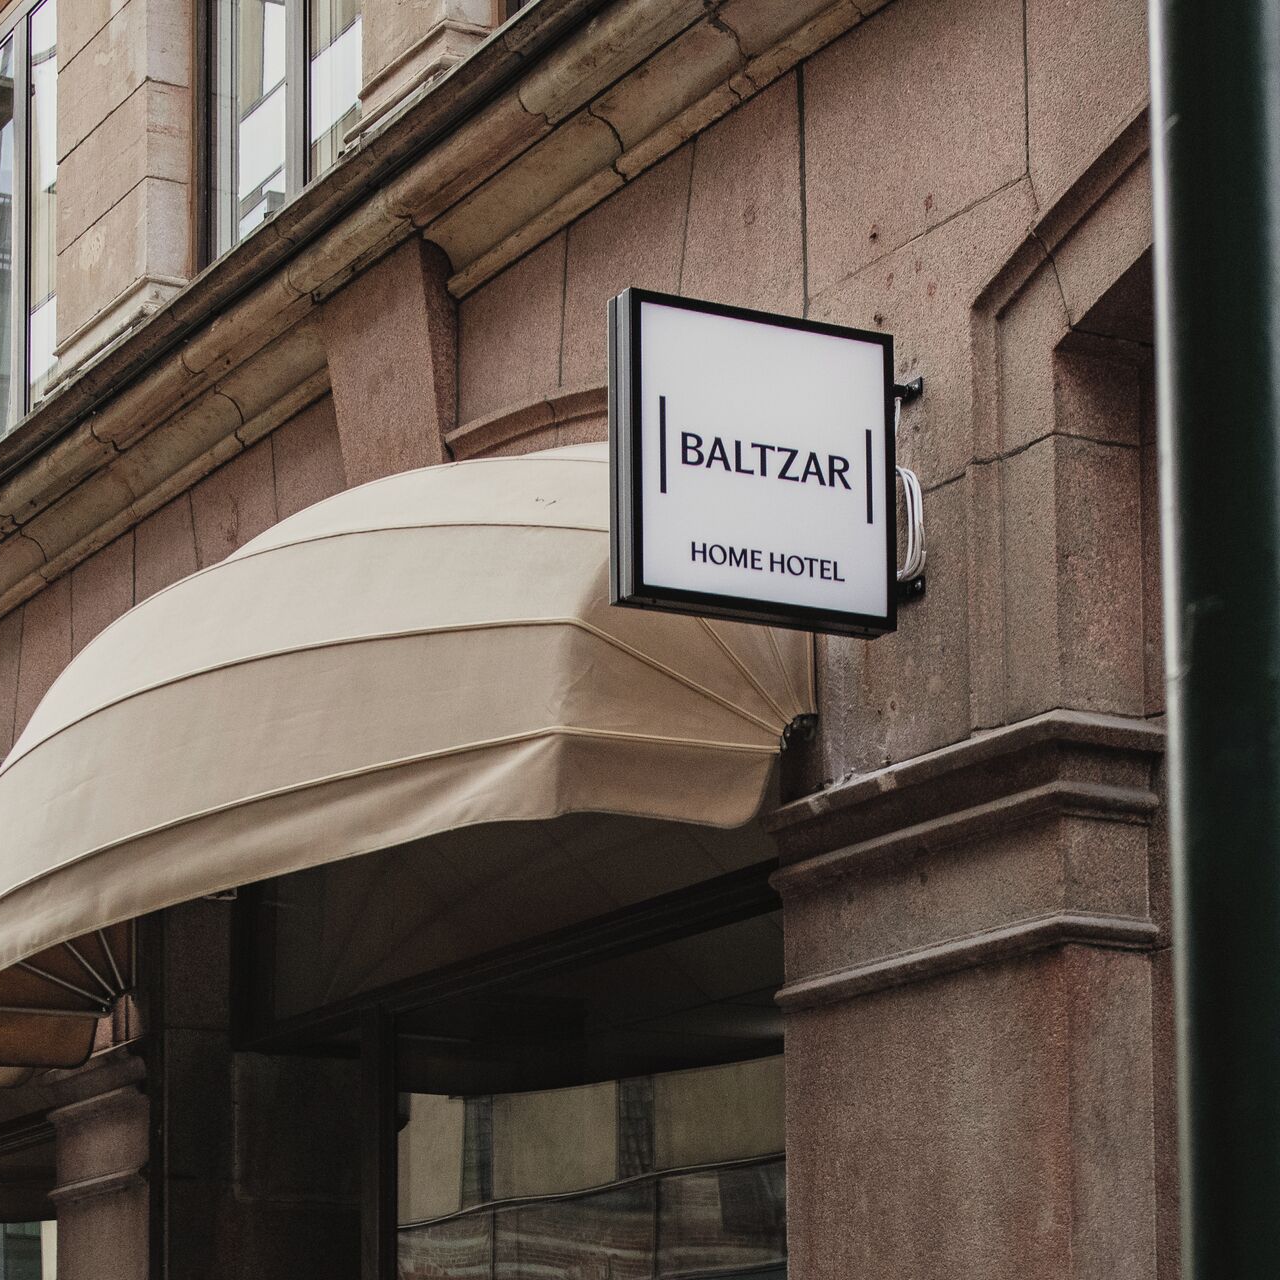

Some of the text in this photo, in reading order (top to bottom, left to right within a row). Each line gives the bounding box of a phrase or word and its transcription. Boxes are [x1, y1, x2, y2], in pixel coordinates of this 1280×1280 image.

[680, 431, 852, 490] BALTZAR
[690, 541, 846, 583] HOME HOTEL
